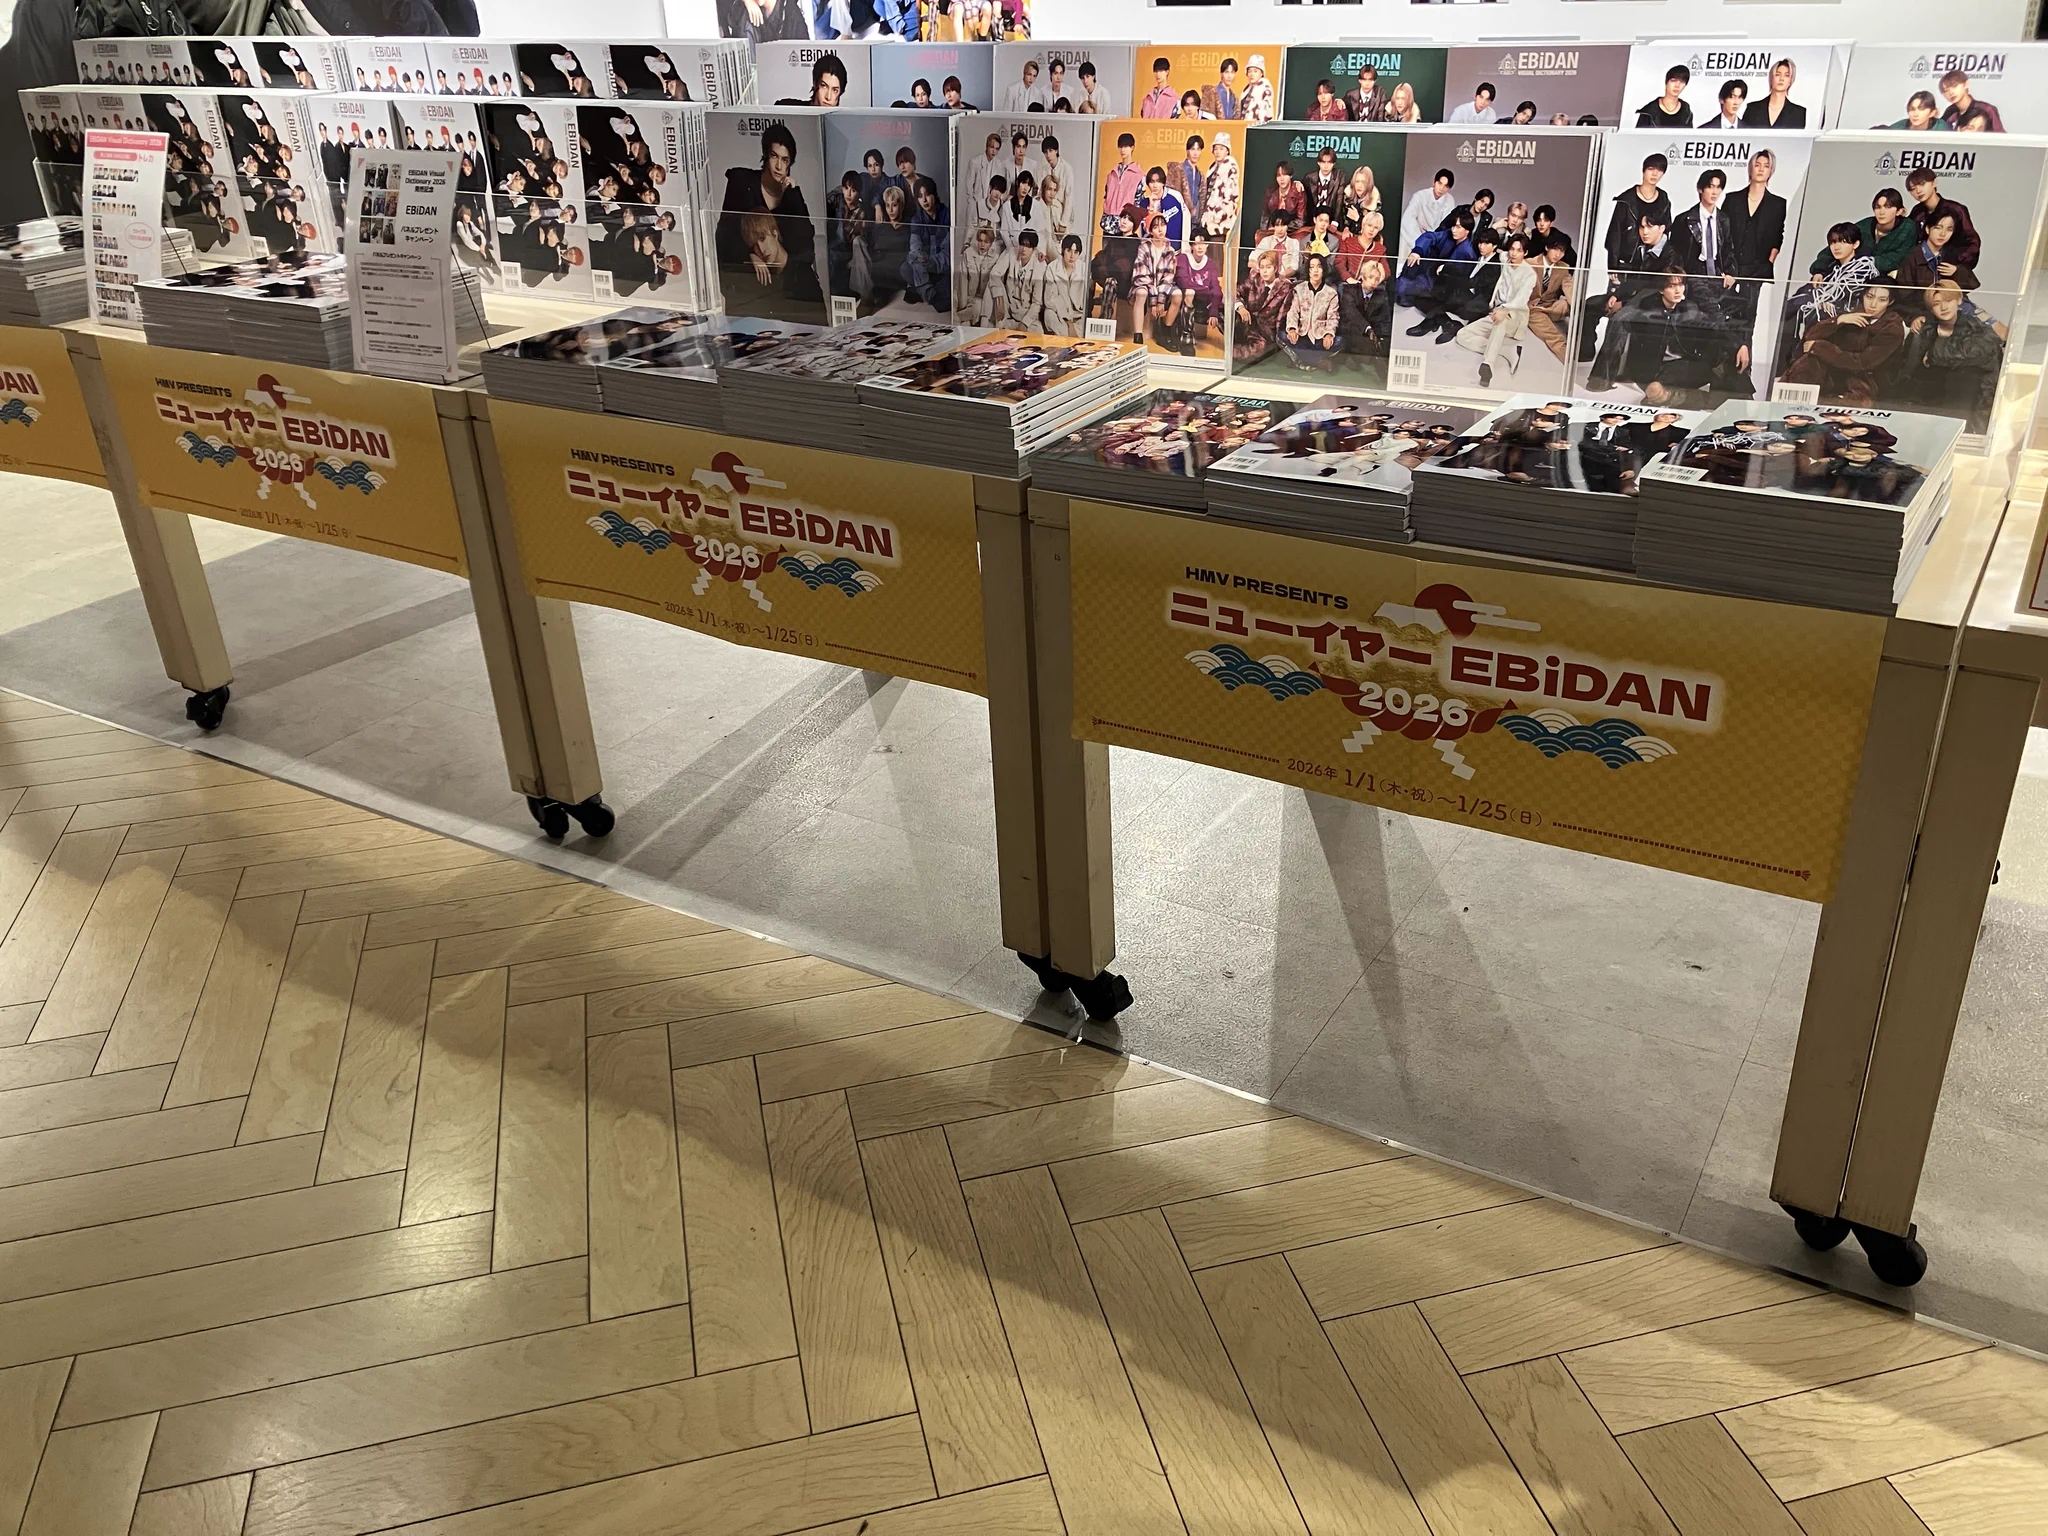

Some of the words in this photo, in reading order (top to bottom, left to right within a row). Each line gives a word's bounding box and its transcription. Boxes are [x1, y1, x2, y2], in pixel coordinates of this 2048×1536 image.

[374, 46, 402, 58] EBiDAN
[460, 48, 488, 60] EBiDAN
[1348, 53, 1401, 70] EBiDAN
[1518, 52, 1579, 69] EBiDAN
[1706, 52, 1772, 70] EBiDAN
[1932, 53, 2006, 72] EBiDAN
[339, 102, 366, 114] EBiDAN
[427, 106, 454, 118] EBiDAN
[286, 112, 302, 152] EBiDAN
[567, 123, 580, 168] EBiDAN
[665, 127, 679, 174] EBiDAN
[1306, 135, 1362, 153] EBiDAN
[1476, 140, 1536, 158] EBiDAN
[1684, 142, 1750, 160] EBiDAN
[1899, 151, 1976, 170] EBiDAN
[406, 205, 438, 216] EBiDAN
[0, 372, 39, 395] AN
[155, 377, 176, 389] HMV
[176, 381, 232, 397] PRESENTS
[156, 396, 277, 434] ニューイヤー
[282, 416, 390, 459] EBiDAN
[252, 446, 303, 472] 2026
[571, 449, 600, 464] HMV
[601, 454, 675, 476] PRESENTS
[568, 470, 730, 519] ニューイヤー
[739, 502, 894, 558] EBiDAN
[693, 535, 760, 570] 2026
[1186, 566, 1229, 586] HMV
[1233, 575, 1348, 610] PRESENTS
[664, 601, 695, 617] 2026年
[1171, 592, 1432, 665] ニューイヤー
[1450, 645, 1711, 722] EBiDAN
[1358, 681, 1468, 727] 2026
[1287, 758, 1338, 780] 2026年
